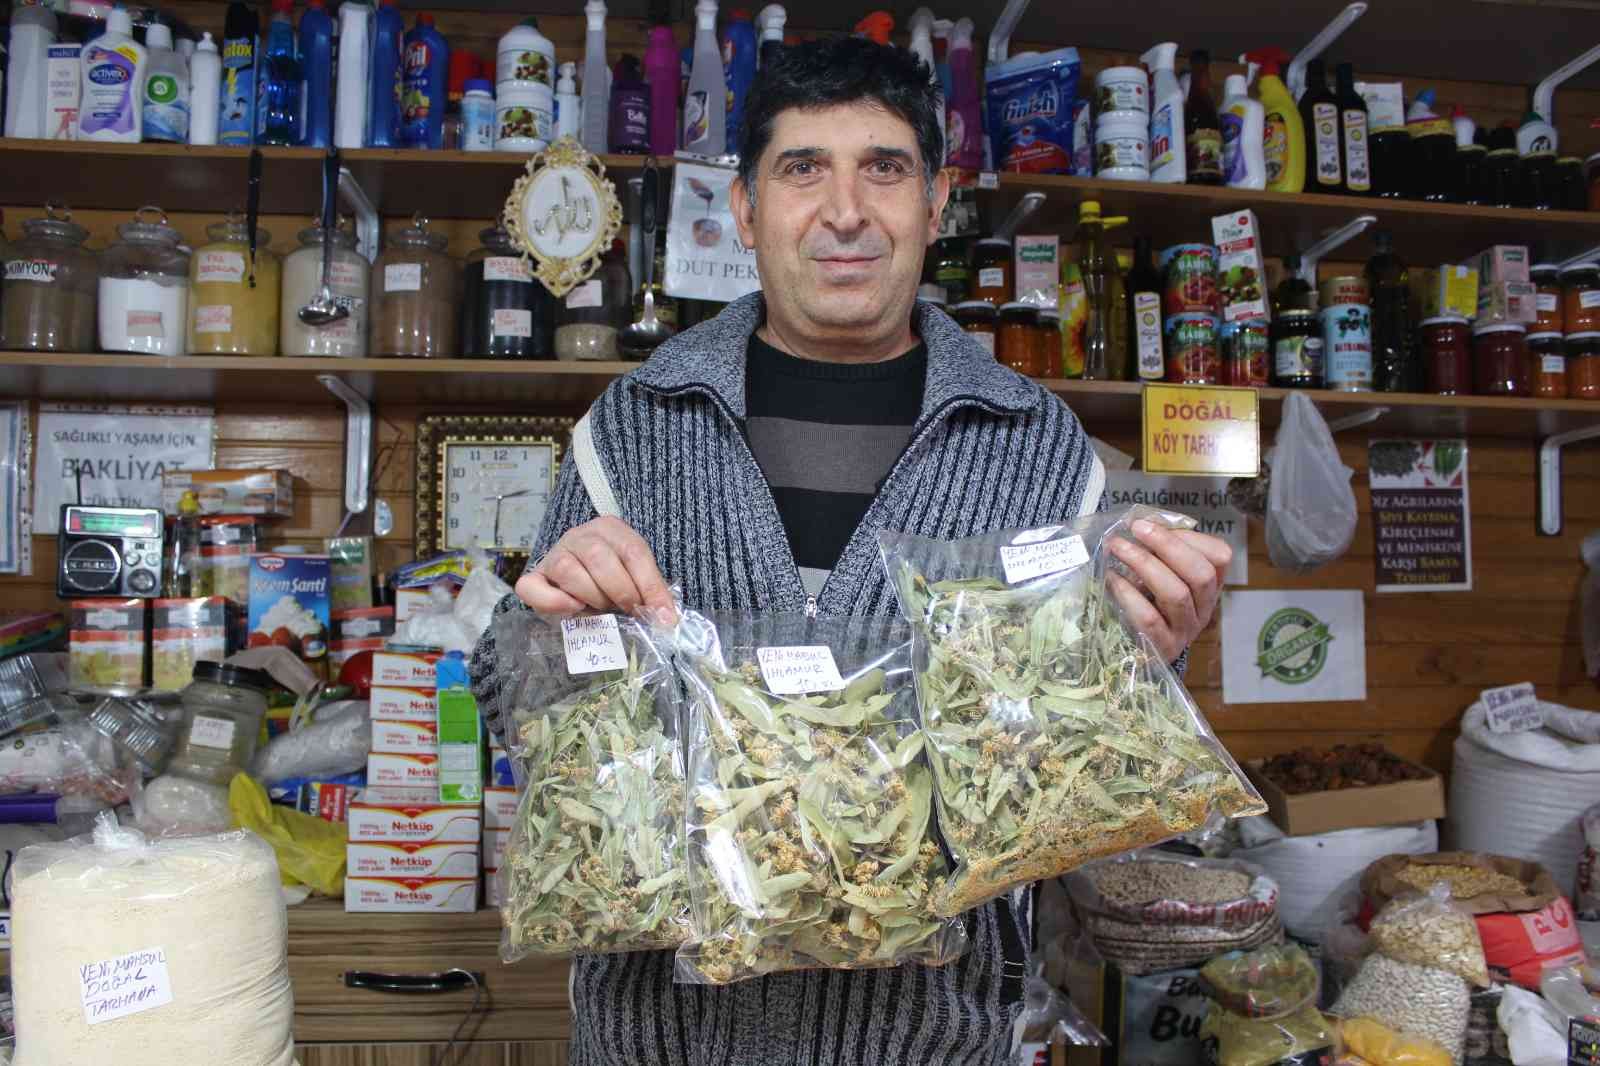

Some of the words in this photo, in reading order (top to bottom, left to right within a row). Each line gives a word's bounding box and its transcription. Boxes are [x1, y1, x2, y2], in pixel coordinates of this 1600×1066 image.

[677, 257, 718, 277] DUT
[723, 262, 758, 281] PEK
[53, 429, 111, 446] SAĞLIKLI
[115, 431, 164, 448] YAŞAM
[168, 430, 196, 449] İÇİN
[1152, 428, 1178, 455] KÖY
[1182, 433, 1220, 457] TARH
[493, 449, 508, 461] 12
[61, 455, 185, 480] BAKLİYAT
[1112, 487, 1200, 505] SAĞLIĞINIZ
[412, 666, 437, 677] Netk
[409, 700, 437, 711] Netk
[391, 820, 433, 832] Netküp
[390, 856, 433, 868] Netküp
[394, 890, 433, 902] Netküp
[1150, 1004, 1202, 1042] Bu
